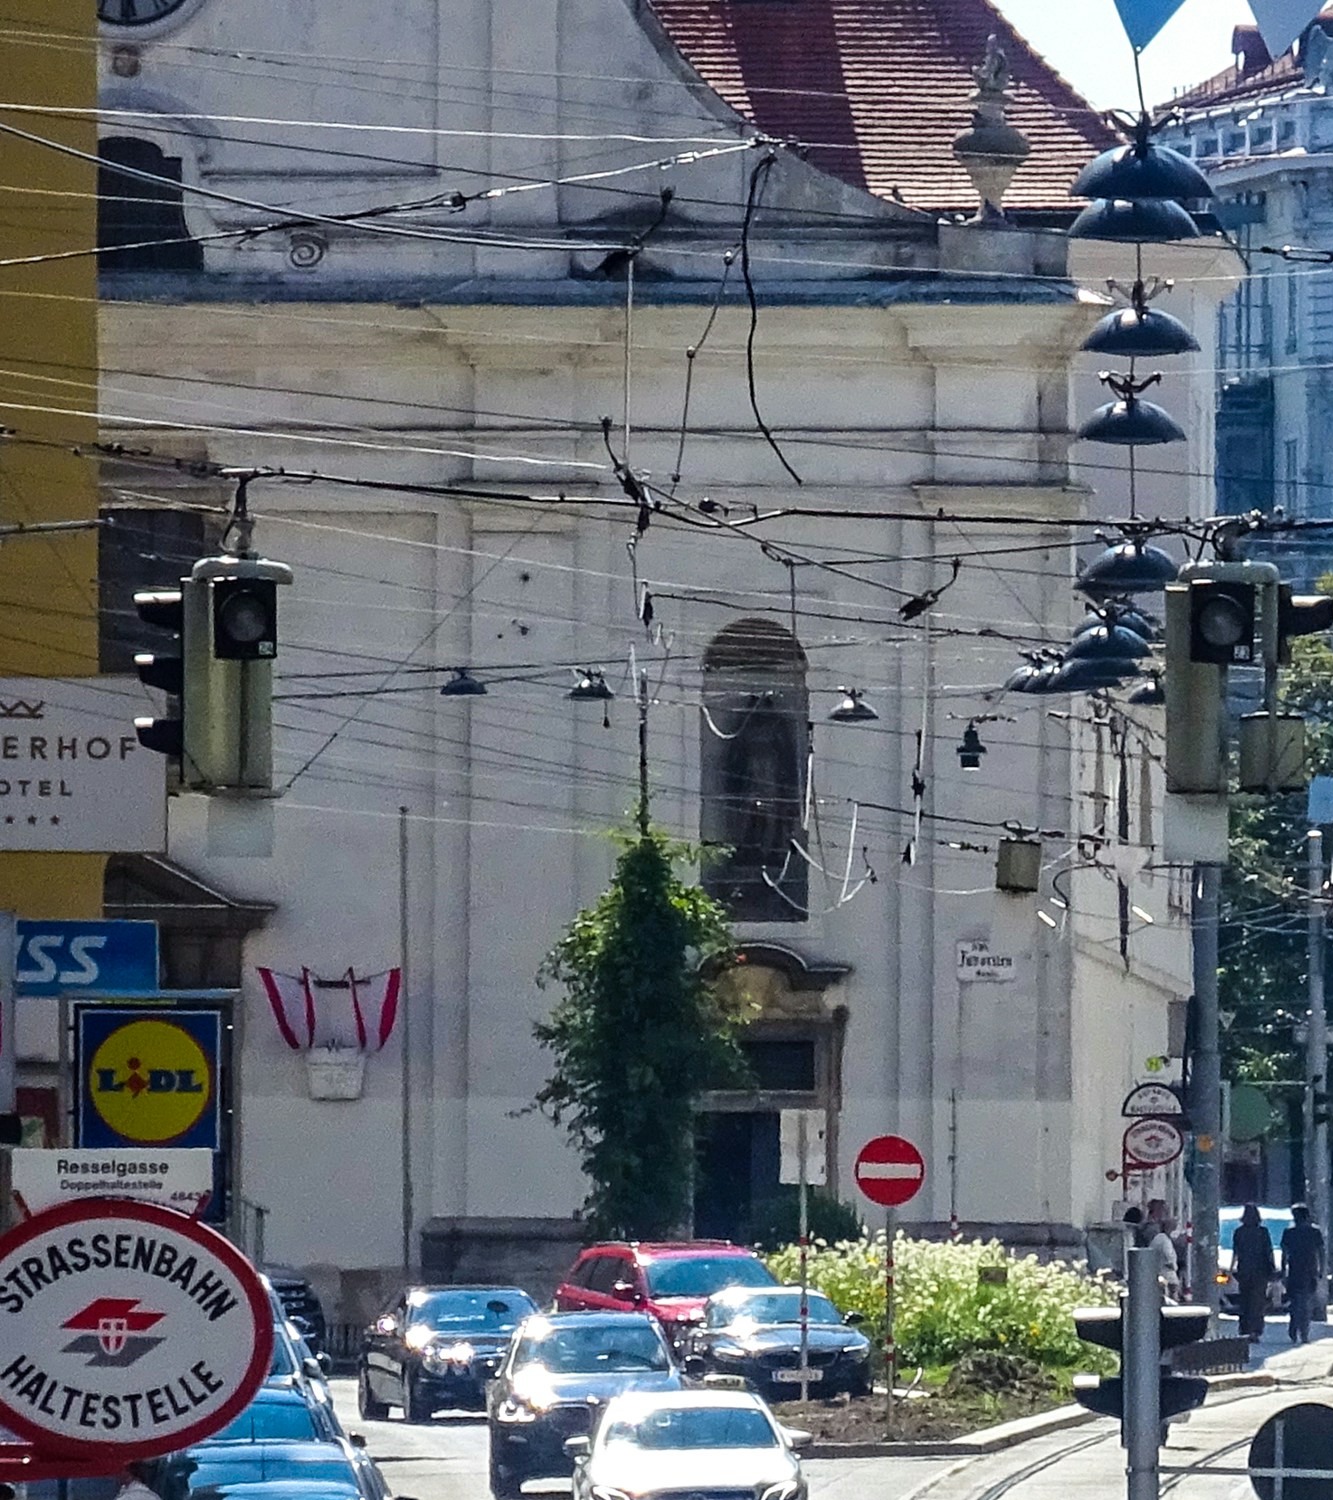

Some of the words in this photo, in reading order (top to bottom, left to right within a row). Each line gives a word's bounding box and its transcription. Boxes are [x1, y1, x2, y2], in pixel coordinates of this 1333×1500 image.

[2, 736, 137, 761] ERHOF
[17, 934, 107, 985] SS
[57, 1159, 170, 1178] Resselgasse
[0, 1234, 239, 1322] STRASSENBAHN
[0, 1354, 224, 1430] HALTESTELLE
